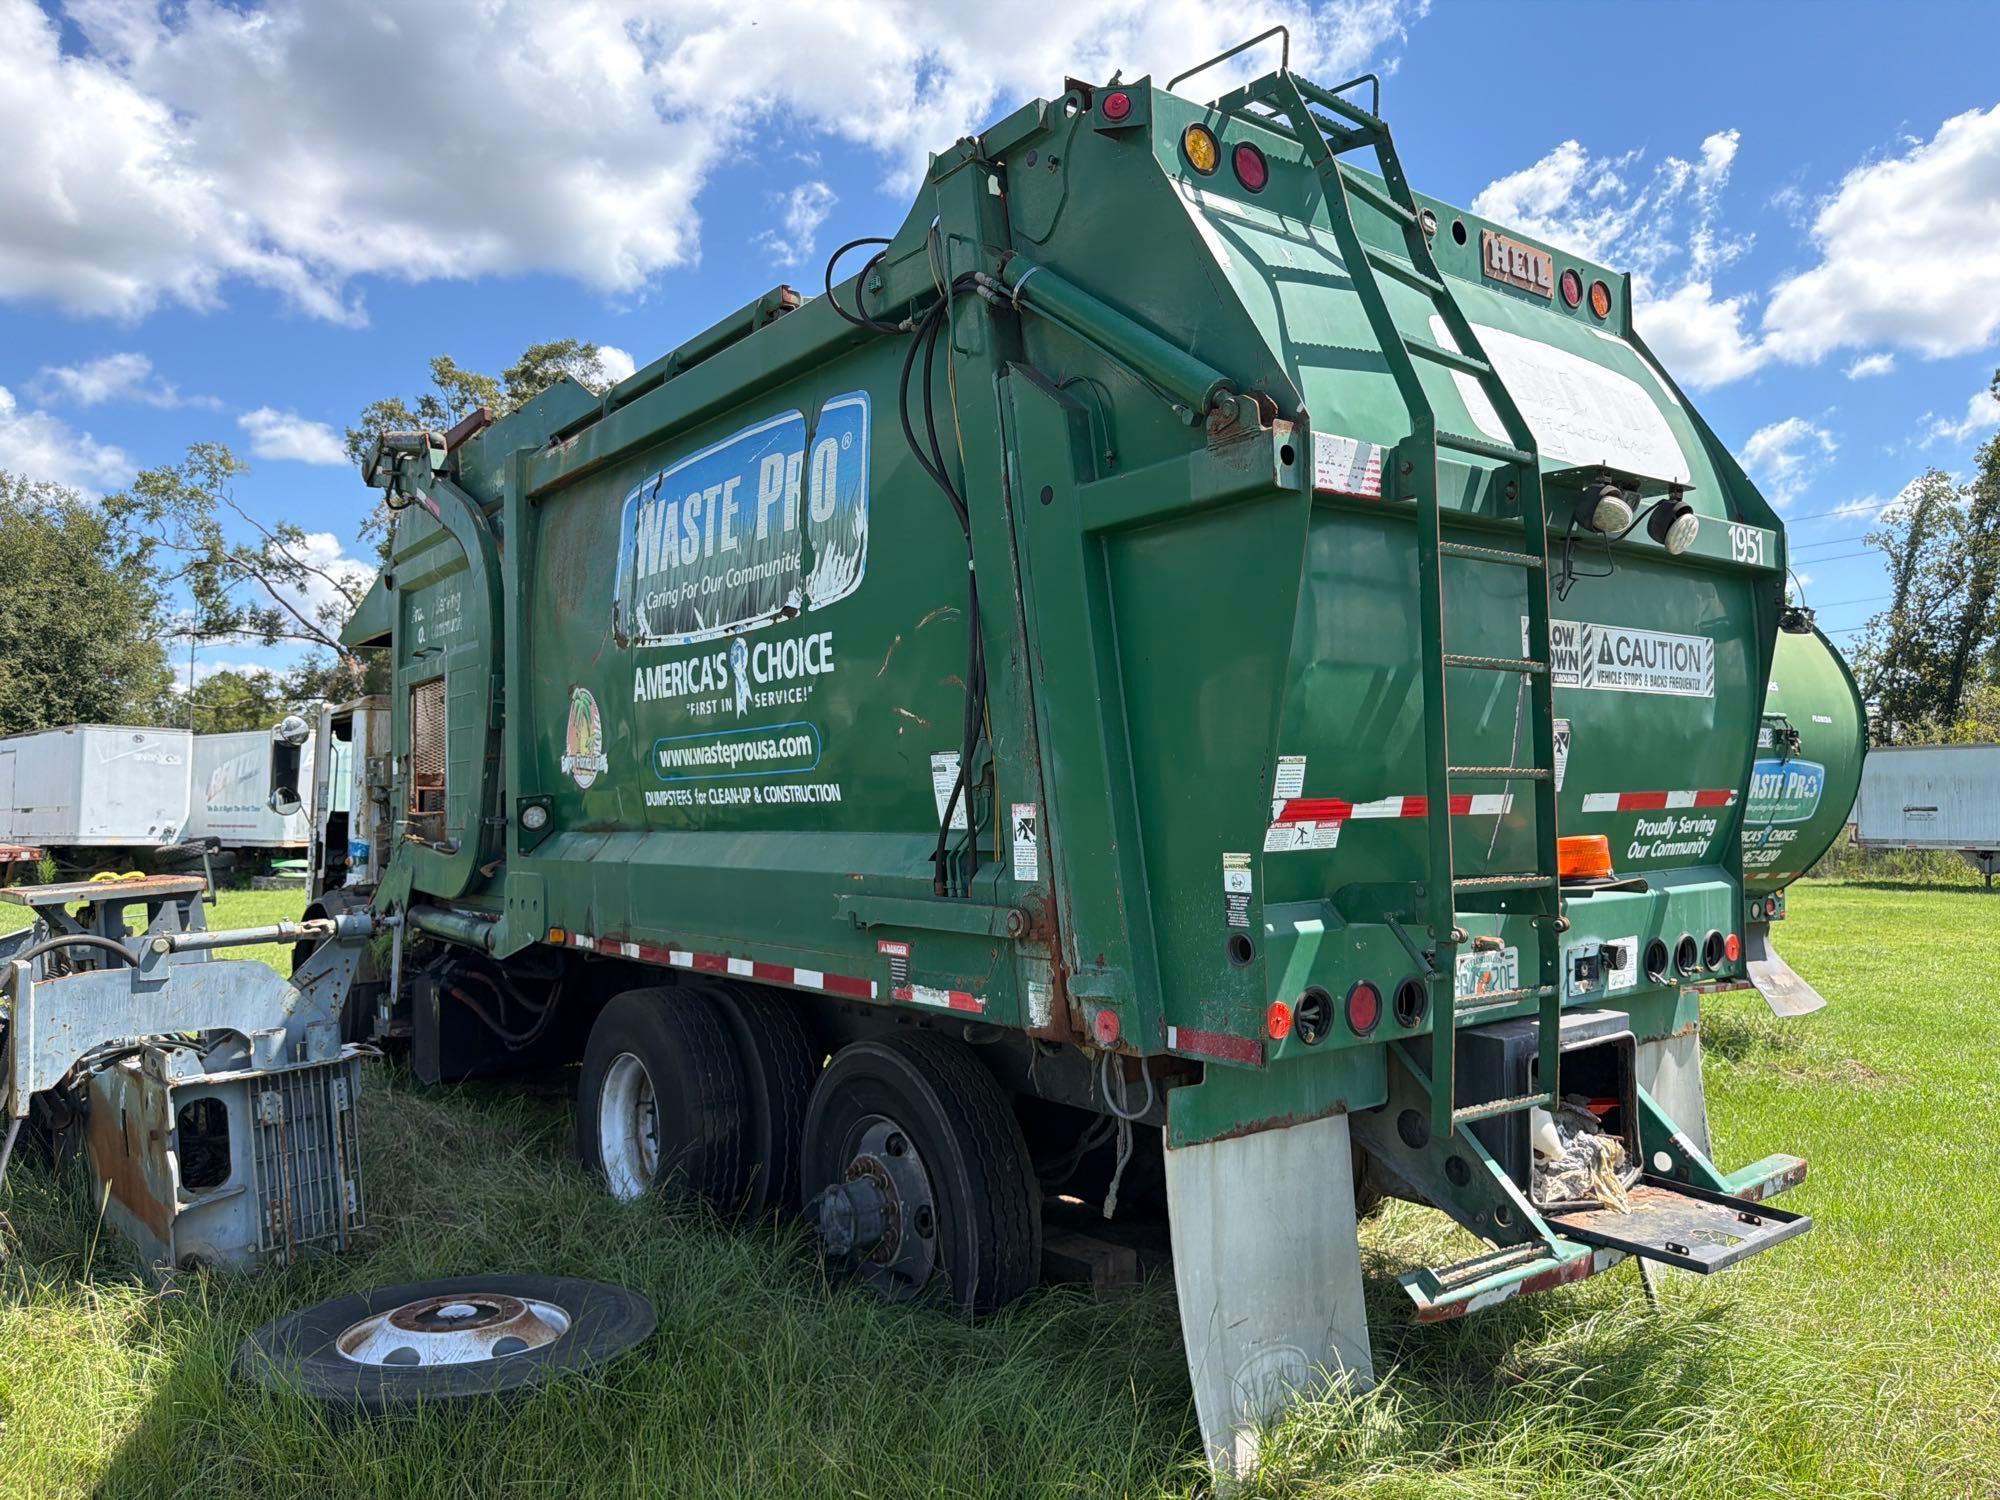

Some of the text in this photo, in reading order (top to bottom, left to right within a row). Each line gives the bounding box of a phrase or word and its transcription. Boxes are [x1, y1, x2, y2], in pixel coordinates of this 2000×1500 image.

[1490, 238, 1550, 288] HEIL
[637, 475, 741, 580] WASTE
[1728, 525, 1764, 565] 1951
[646, 551, 801, 610] Caring For Our Communitie
[1550, 625, 1575, 648] OW
[633, 631, 835, 703] AMERICA'S CHOICE
[1616, 636, 1701, 673] CAUTION
[1597, 670, 1701, 691] VEHICLE STOPS & BACKS FREQUENTLY
[721, 698, 733, 712] IN
[754, 686, 813, 708] SERVICE!"
[659, 735, 812, 769] www.wasteprousa.com
[694, 787, 707, 805] for
[708, 786, 750, 805] CLEAN-UP
[753, 786, 762, 803] &
[763, 784, 842, 804] CONSTRUCTION
[1634, 814, 1717, 840] Proudly Serving
[1627, 836, 1711, 860] Our Community
[886, 943, 907, 956] DANGER
